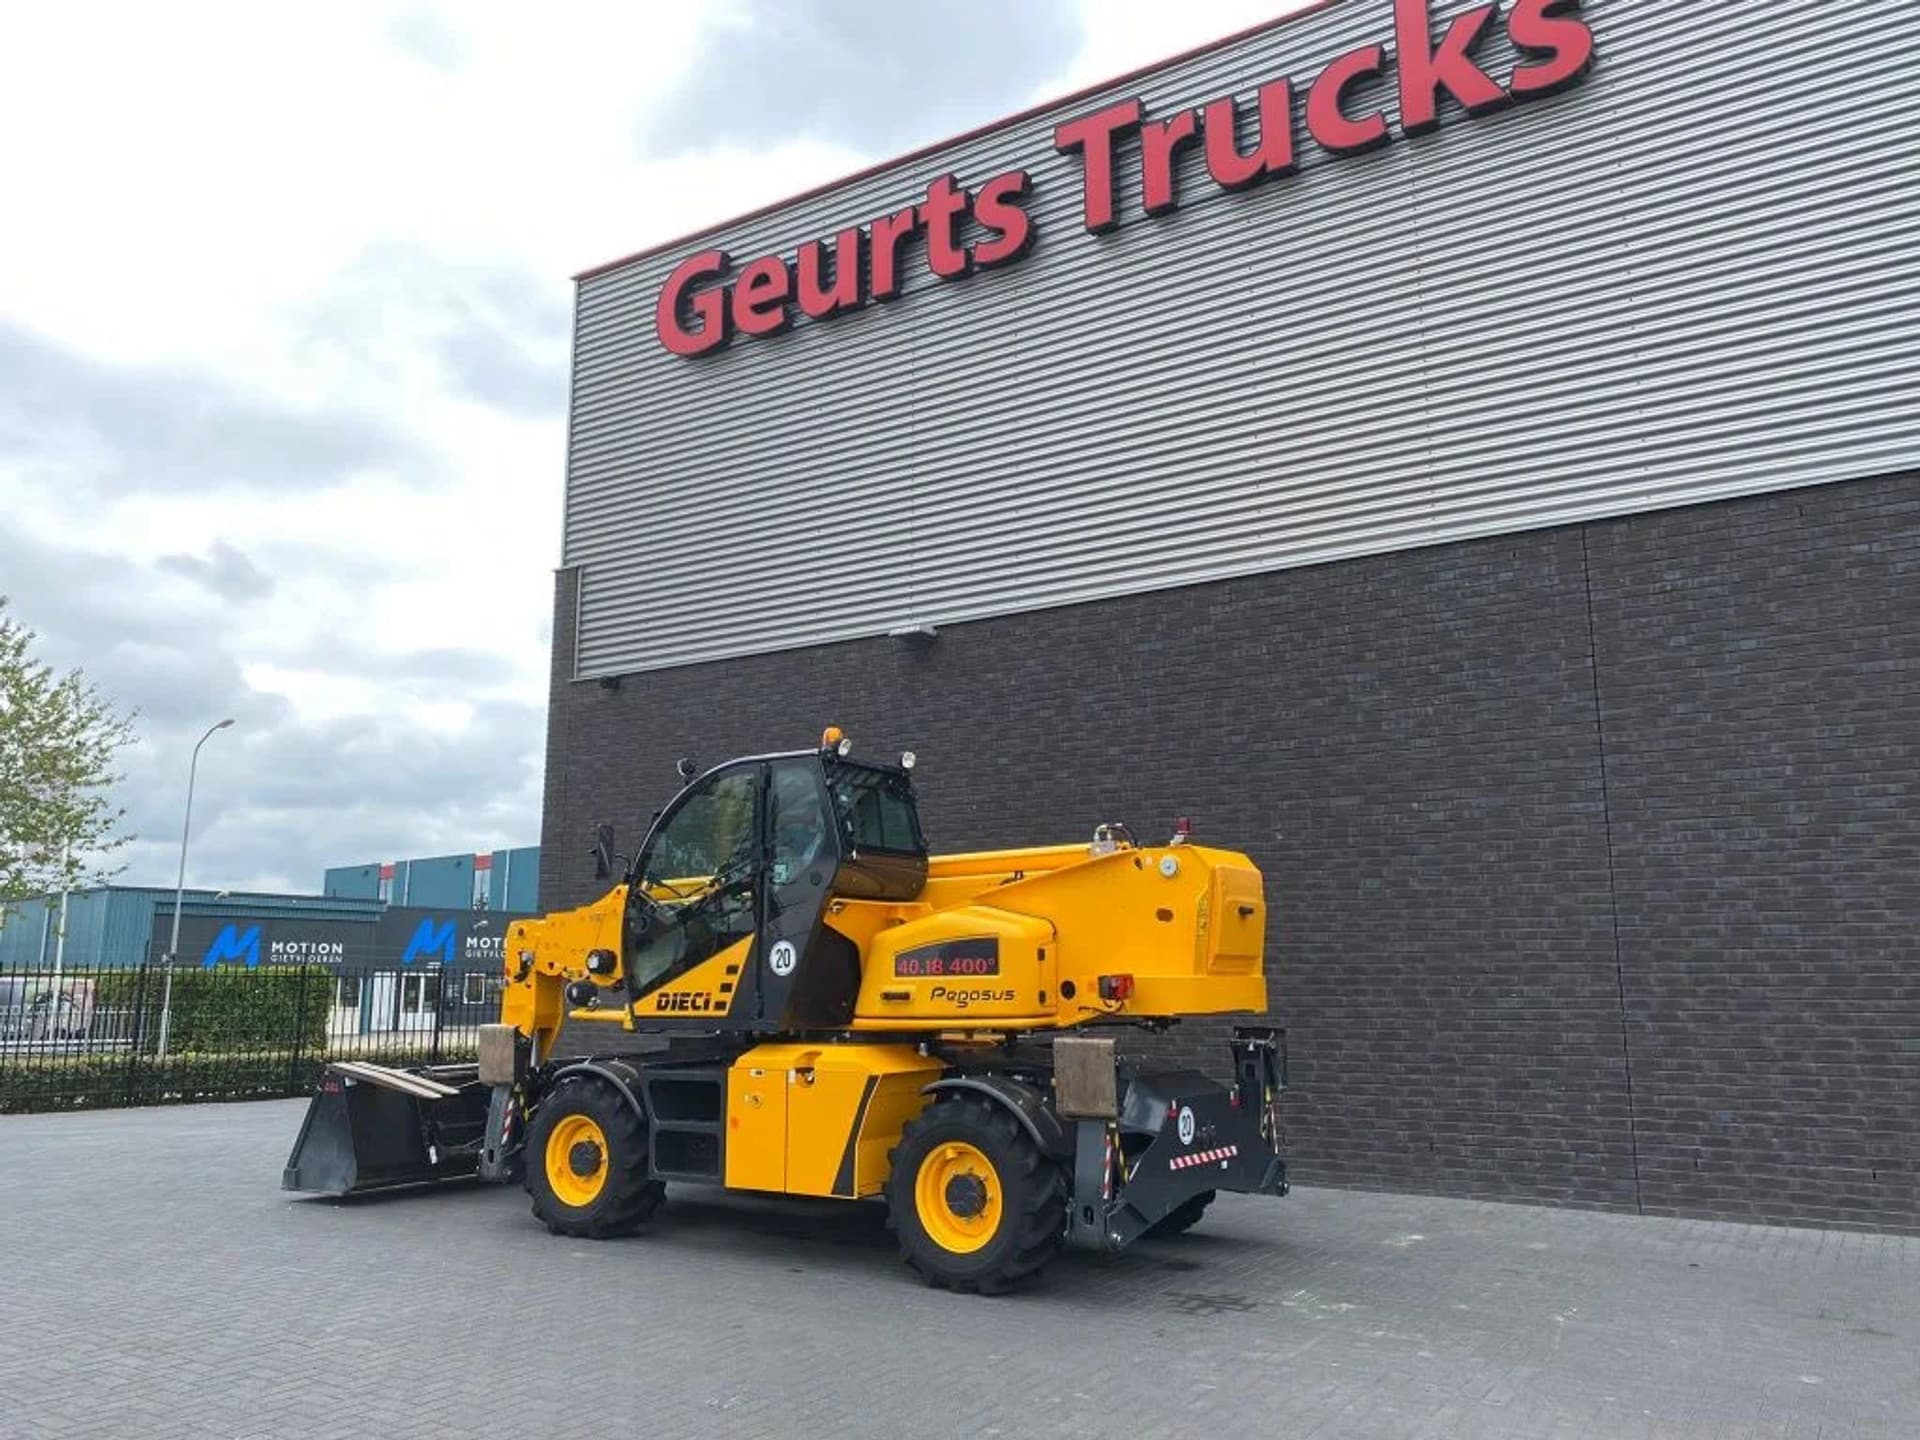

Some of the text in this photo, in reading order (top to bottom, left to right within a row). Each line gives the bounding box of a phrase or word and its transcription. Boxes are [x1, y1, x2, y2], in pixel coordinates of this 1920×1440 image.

[656, 0, 1595, 358] Geurts Trucks
[271, 941, 343, 954] MOTION
[775, 949, 790, 969] 20
[930, 986, 1016, 1008] Pegasus
